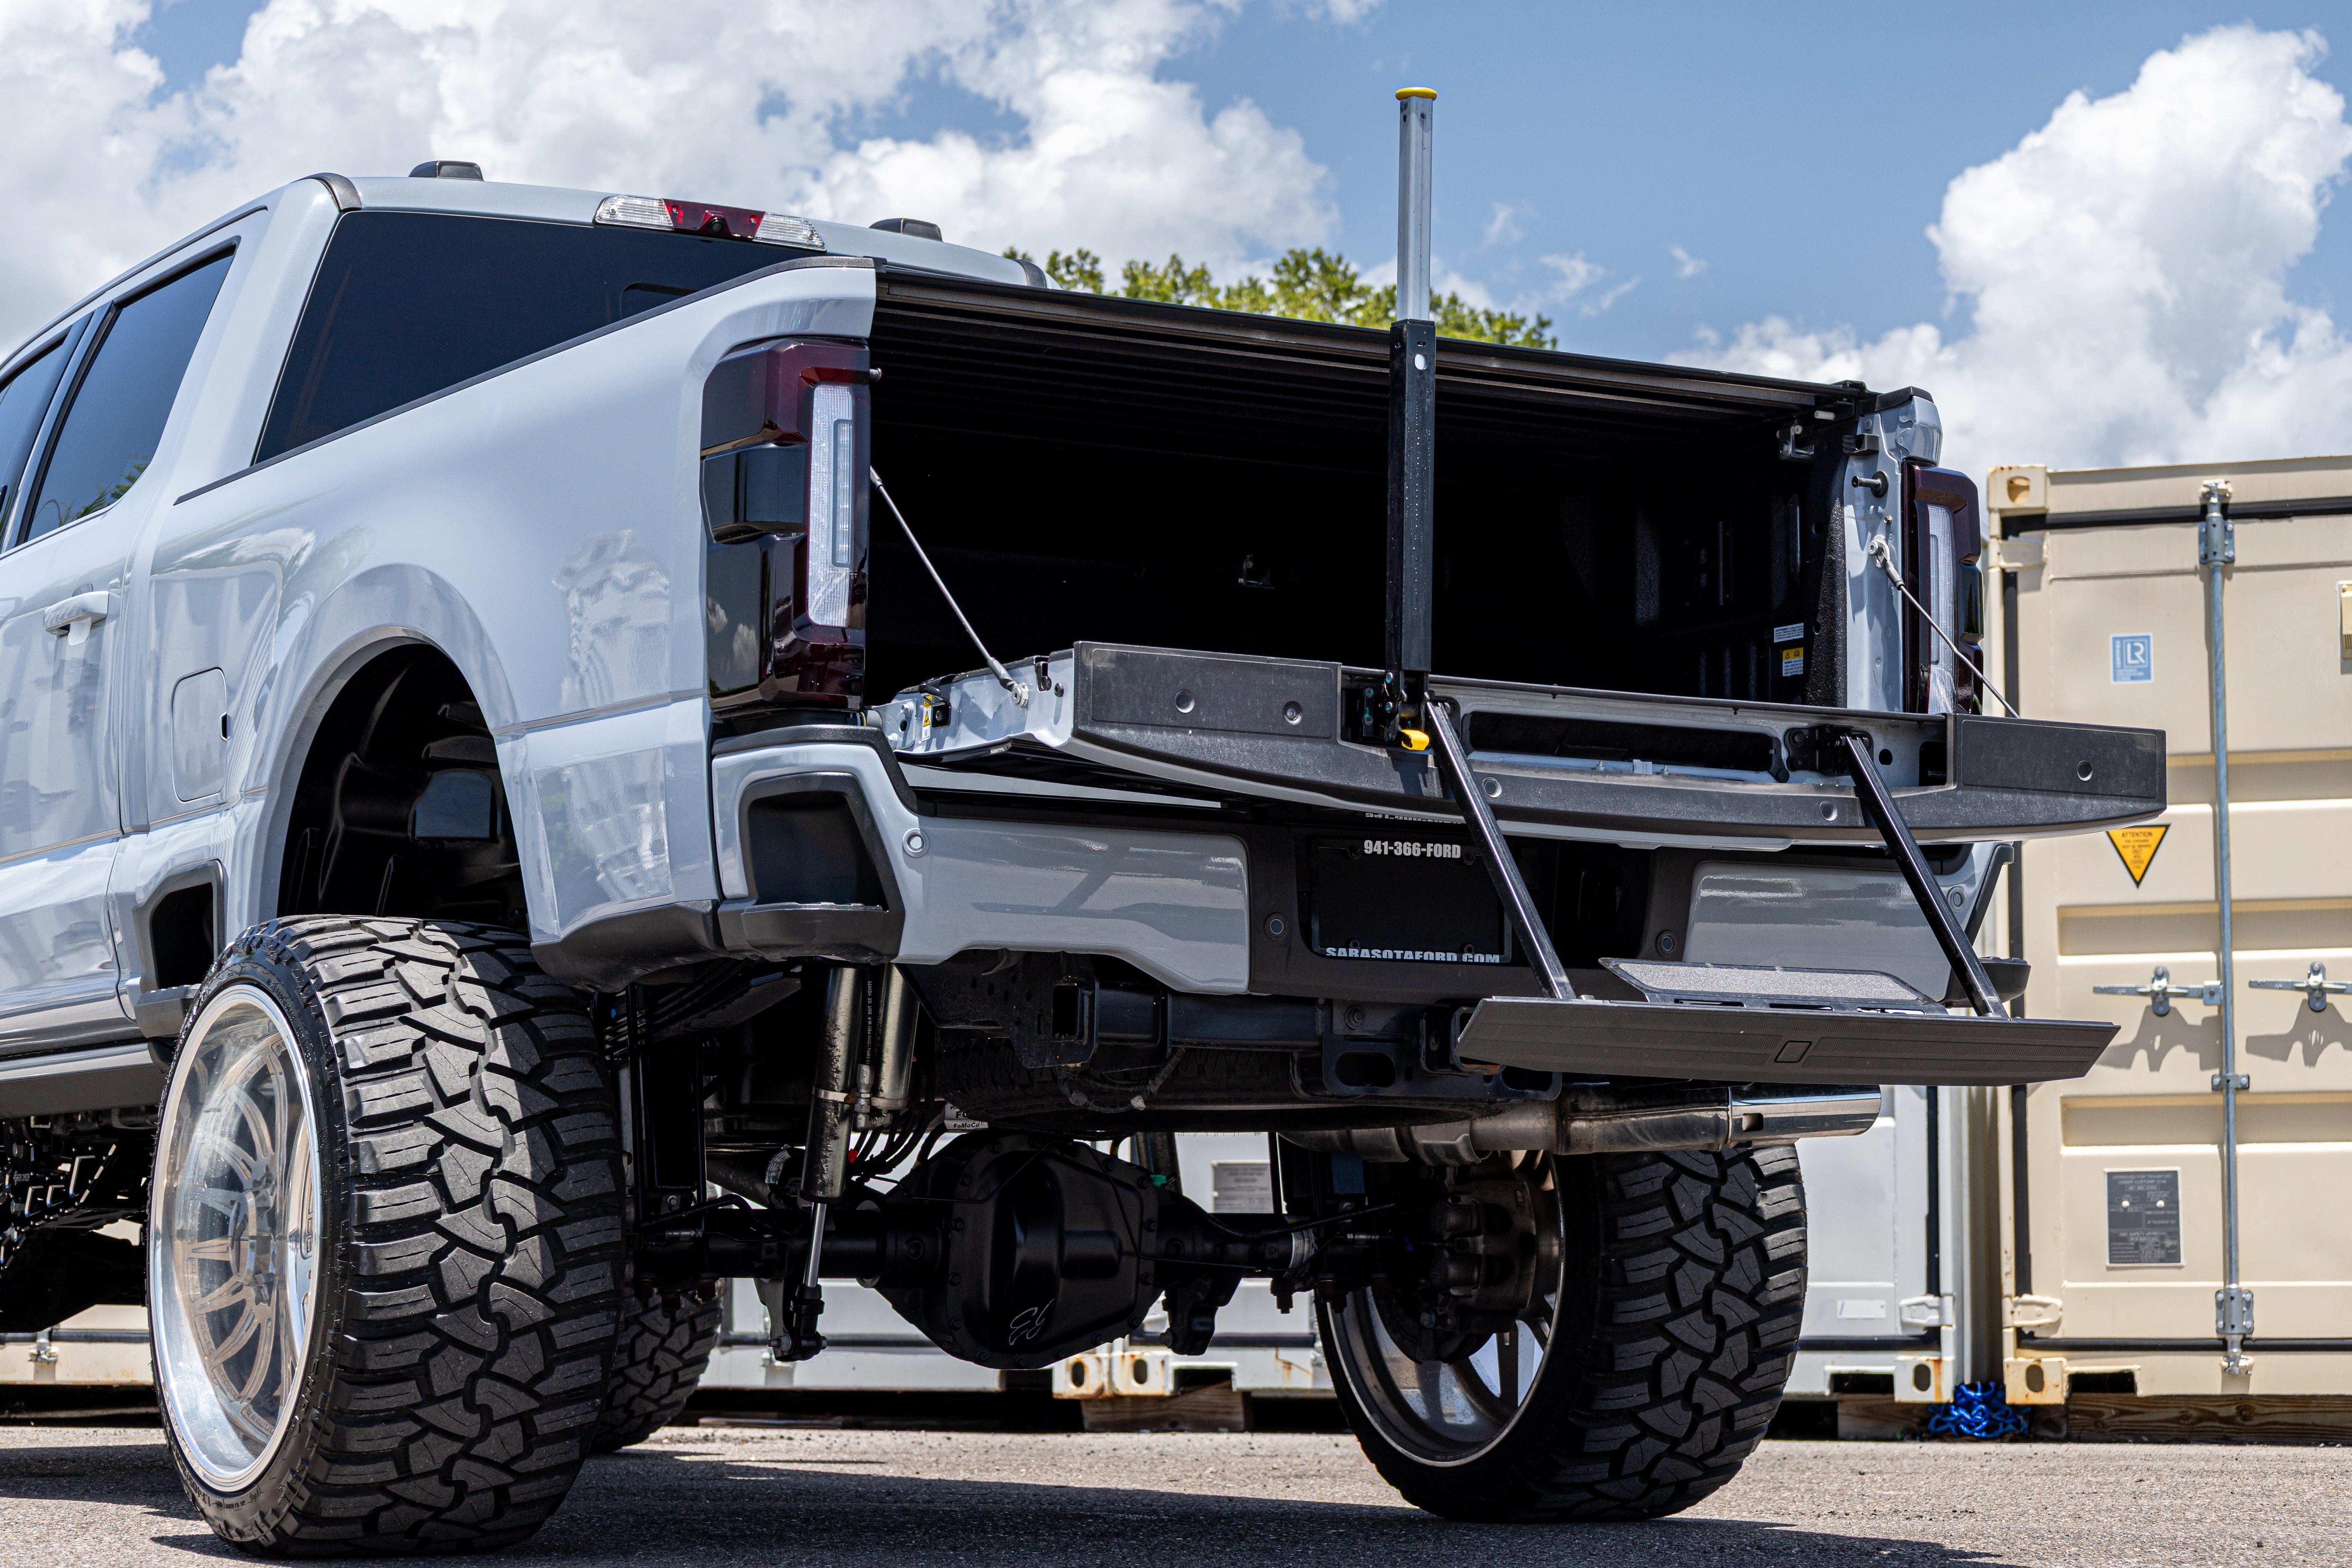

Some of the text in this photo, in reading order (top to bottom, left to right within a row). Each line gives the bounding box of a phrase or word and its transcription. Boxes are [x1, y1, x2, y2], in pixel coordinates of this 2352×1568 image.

[2127, 642, 2145, 664] LR
[1364, 840, 1461, 858] 941-366-FORD
[1326, 947, 1499, 963] SARASOTAFORDCOM
